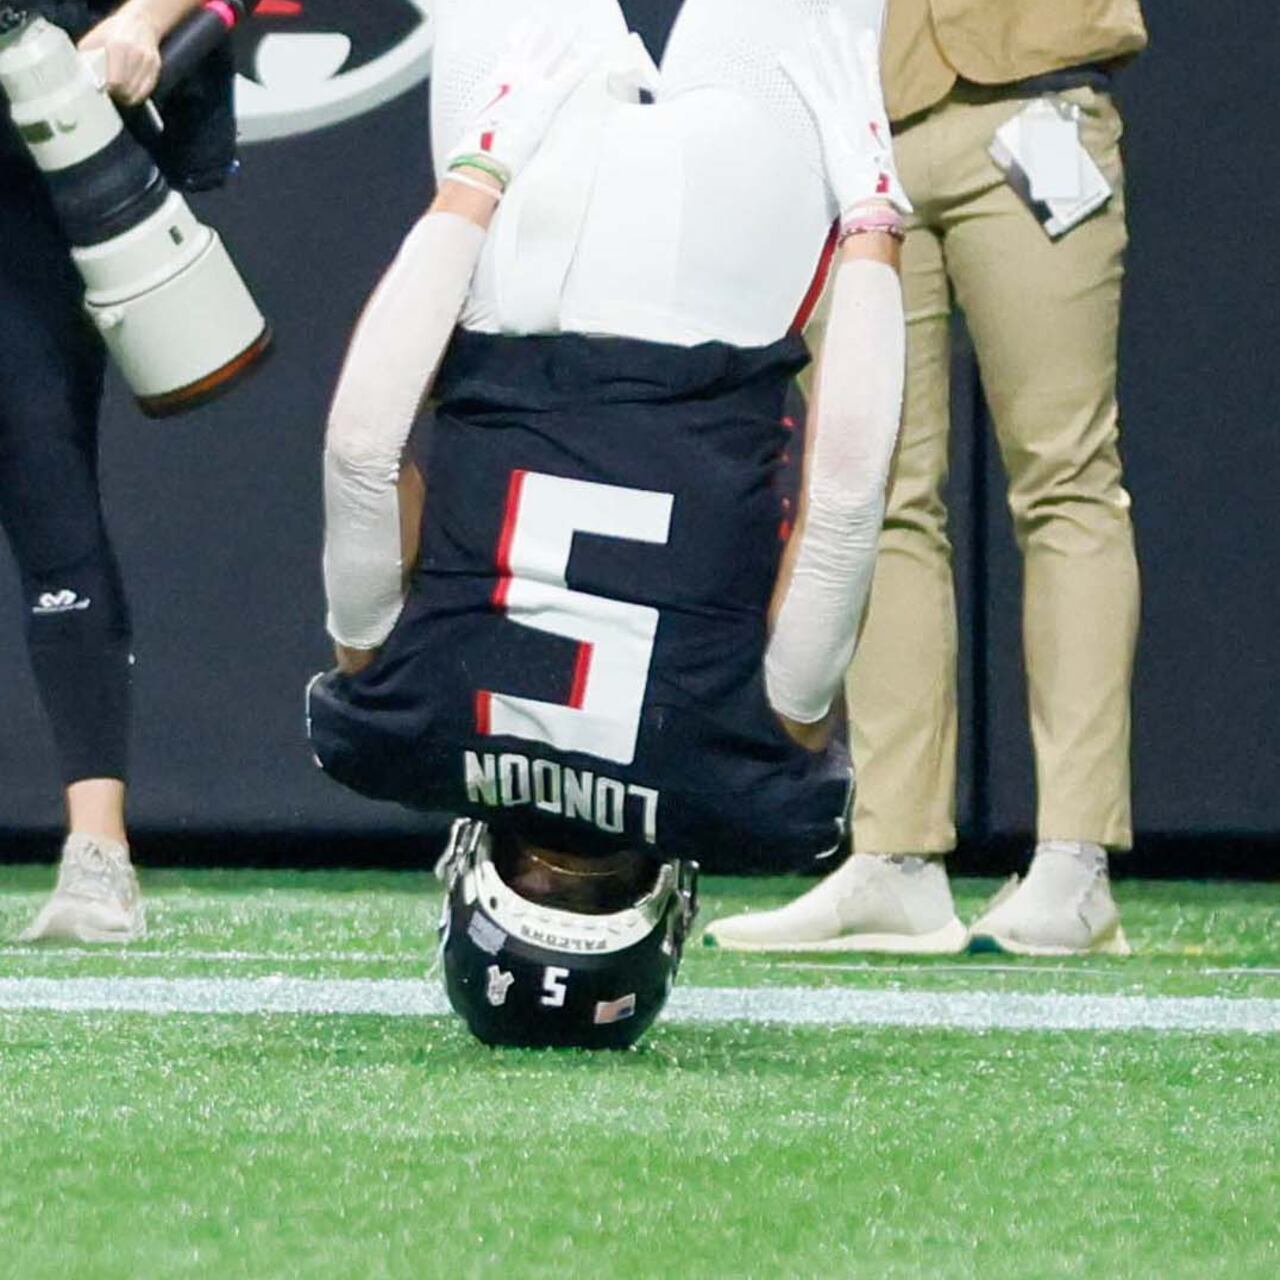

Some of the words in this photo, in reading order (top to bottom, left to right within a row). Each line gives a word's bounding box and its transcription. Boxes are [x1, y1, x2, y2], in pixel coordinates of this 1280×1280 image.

[475, 468, 675, 766] 5
[463, 749, 660, 845] LONDON
[540, 965, 570, 1007] 5
